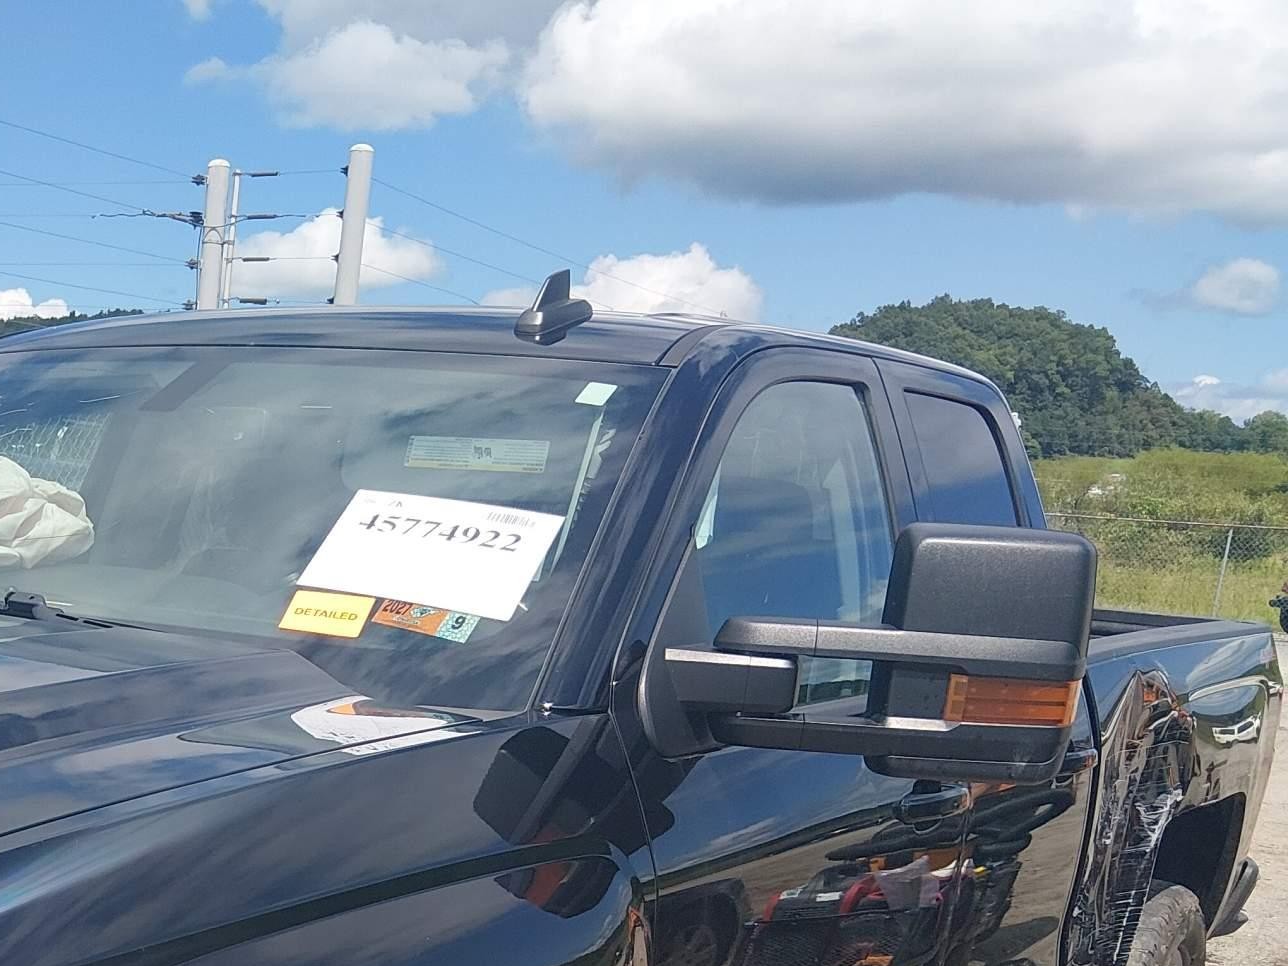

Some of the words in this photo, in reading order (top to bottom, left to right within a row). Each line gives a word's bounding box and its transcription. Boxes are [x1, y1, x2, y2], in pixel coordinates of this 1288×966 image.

[359, 513, 522, 552] 45774922
[294, 607, 358, 621] DETAILED
[381, 599, 413, 616] 2027
[451, 615, 466, 630] 9
